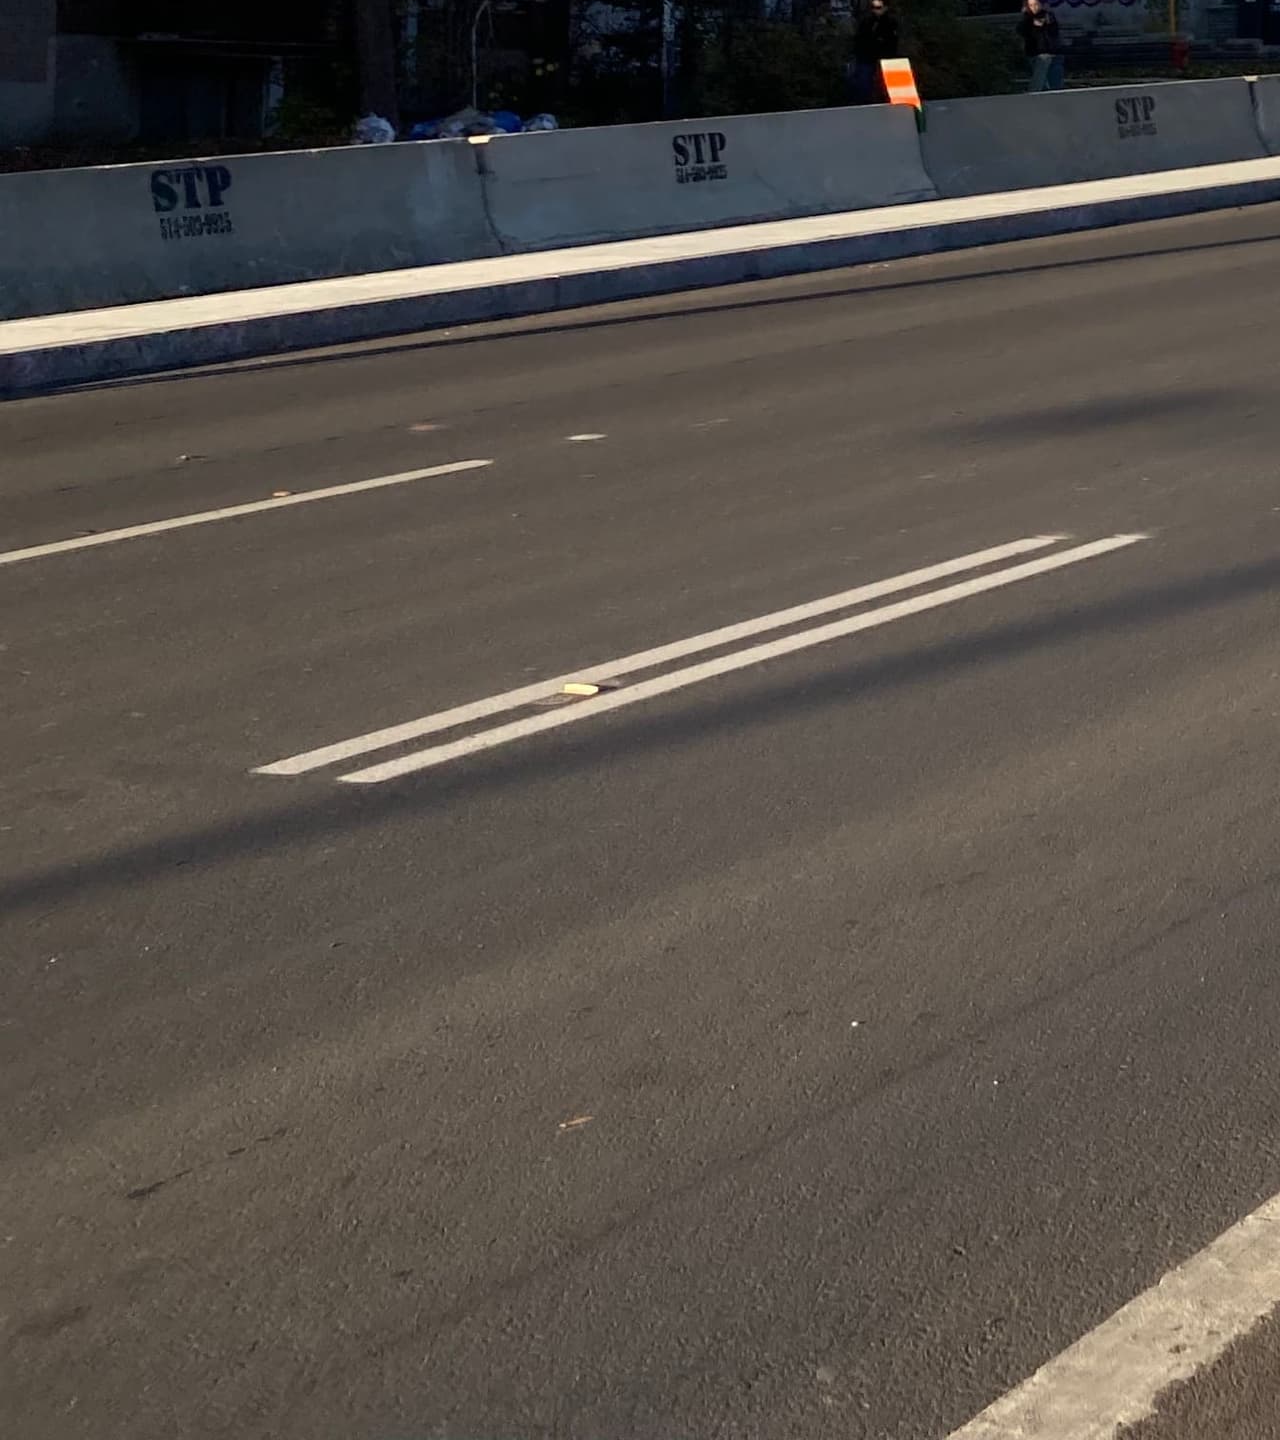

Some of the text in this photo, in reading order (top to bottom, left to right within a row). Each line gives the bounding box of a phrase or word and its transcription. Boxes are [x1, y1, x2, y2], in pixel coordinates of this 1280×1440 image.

[1115, 96, 1155, 125] STP
[672, 132, 727, 167] STP
[151, 164, 233, 213] STP
